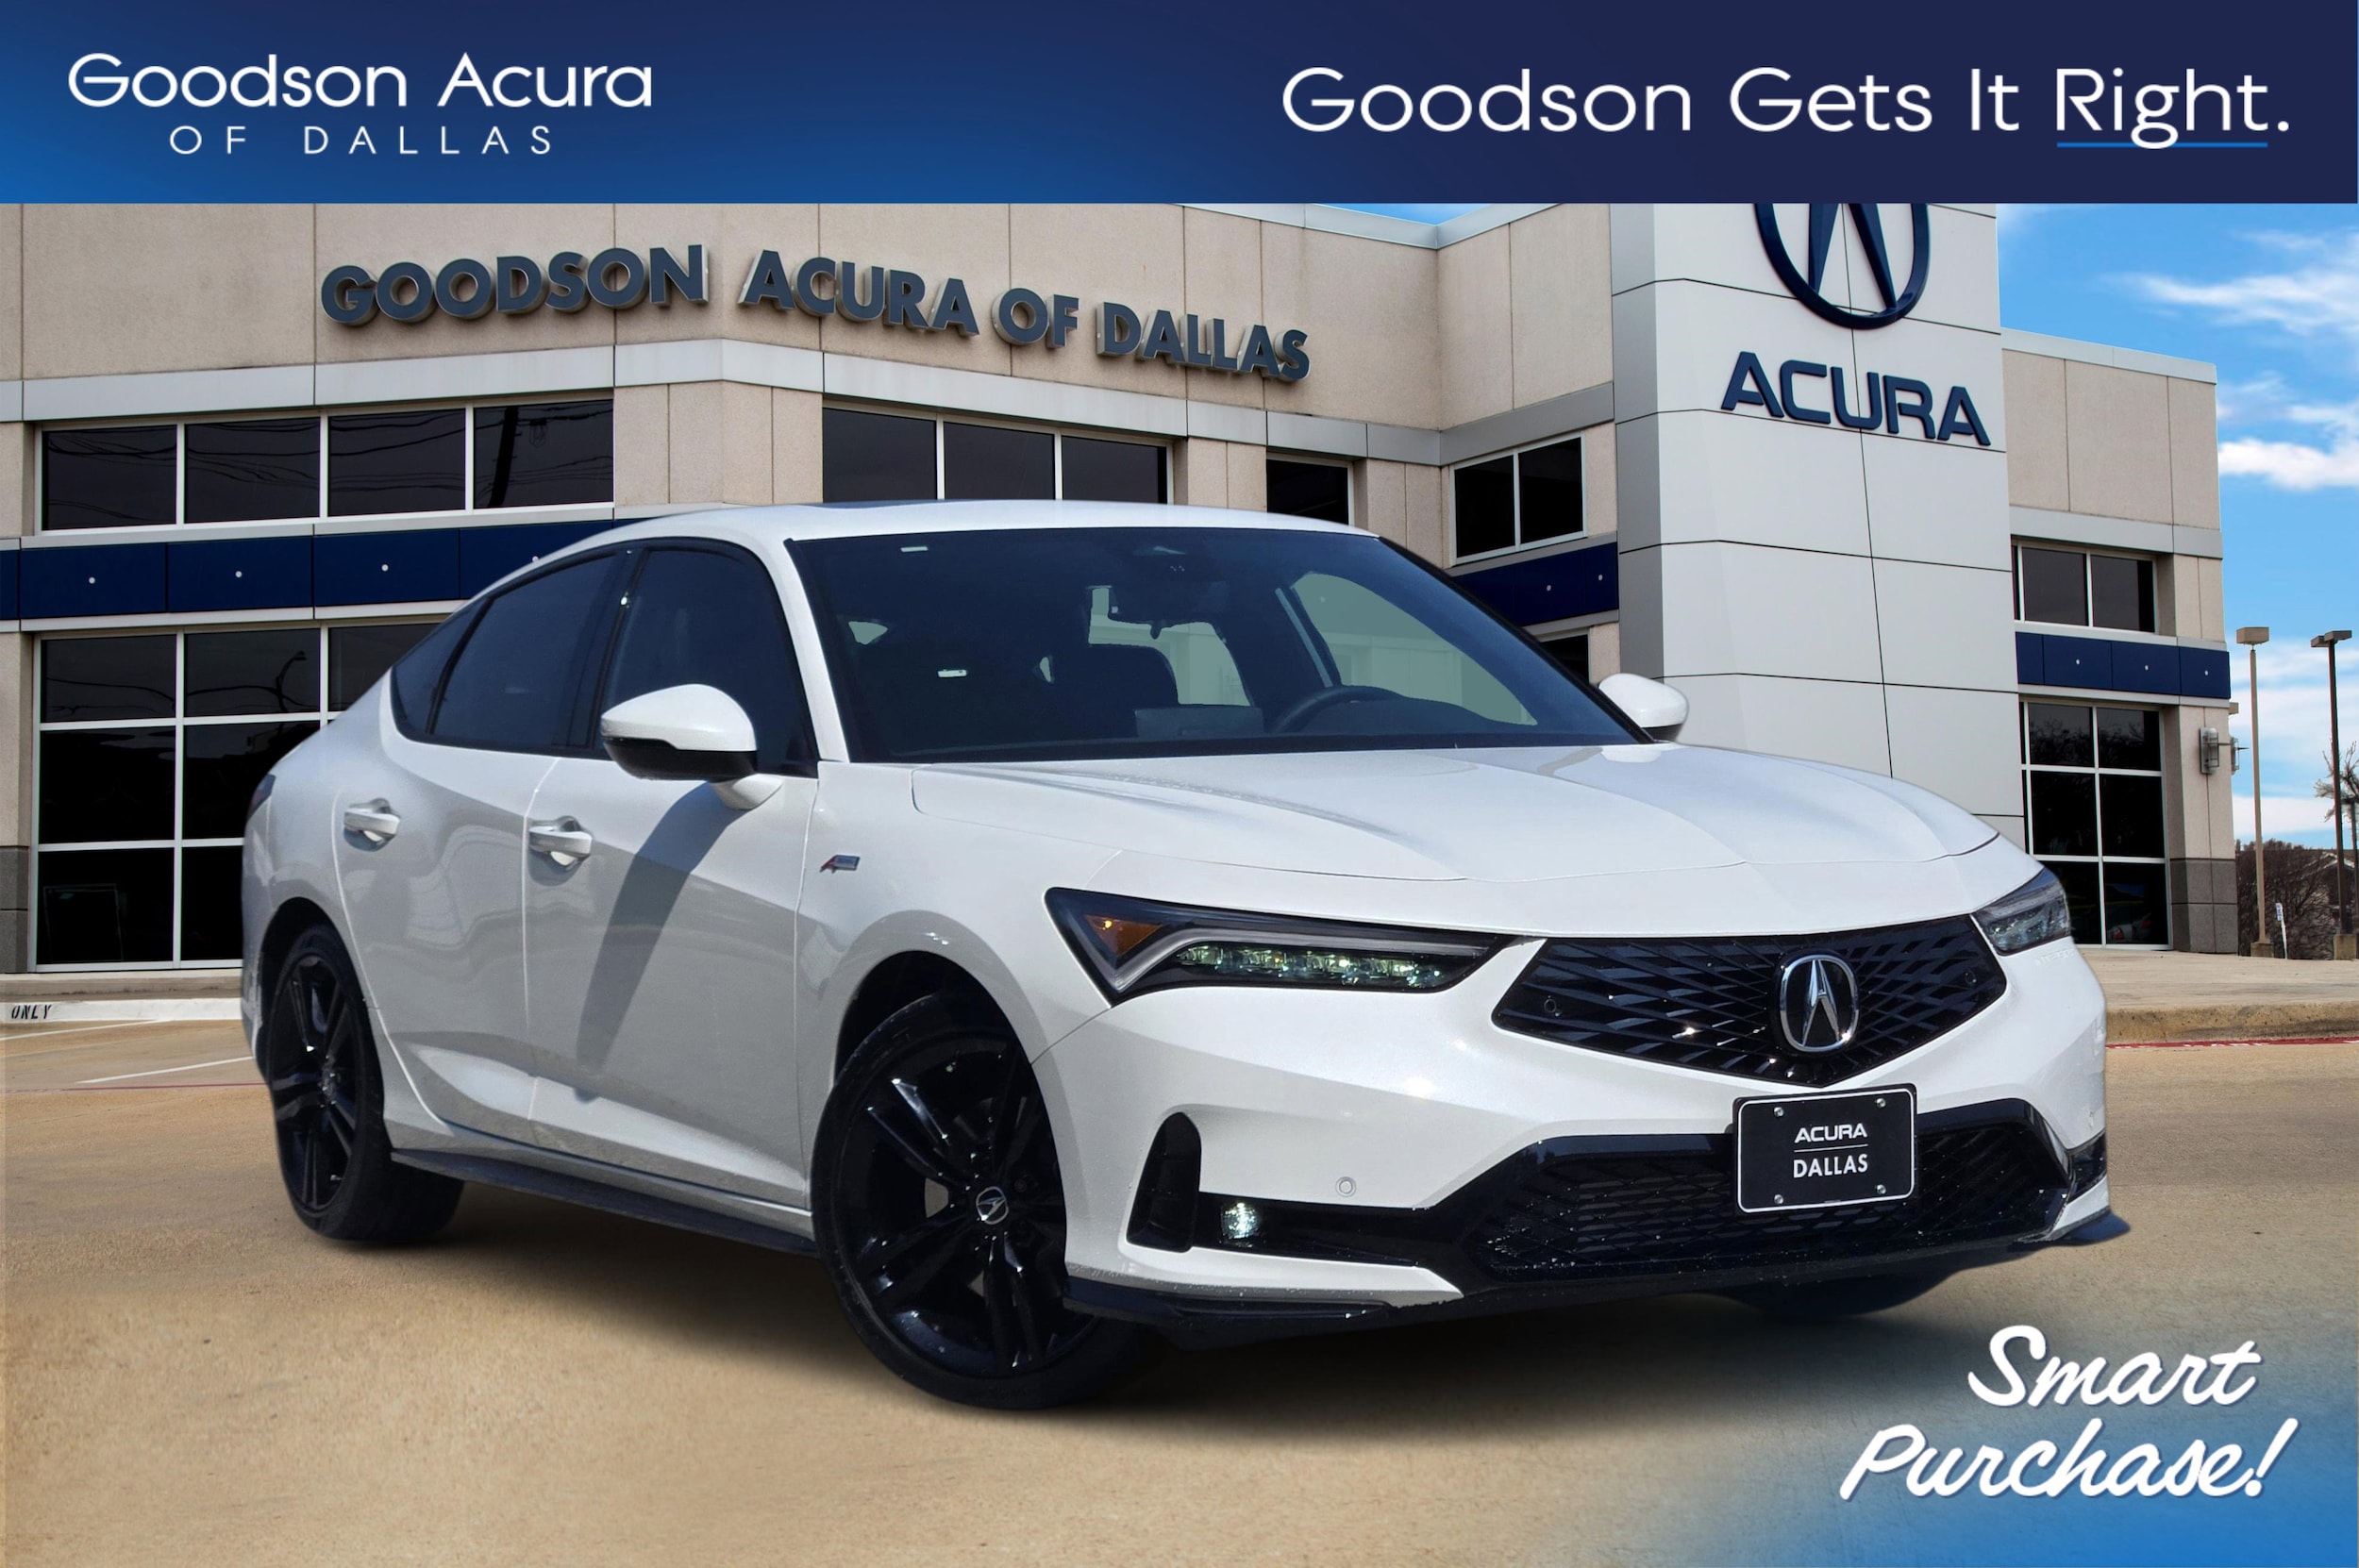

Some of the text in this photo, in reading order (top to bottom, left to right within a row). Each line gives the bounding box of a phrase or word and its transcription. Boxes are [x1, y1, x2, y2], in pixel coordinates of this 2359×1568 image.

[321, 244, 1311, 381] GOODSON ACURA OF DALLAS
[1720, 351, 1991, 446] ACURA
[11, 1004, 53, 1020] ONLY
[1794, 1123, 1868, 1143] ACURA
[1793, 1153, 1868, 1178] DALLAS
